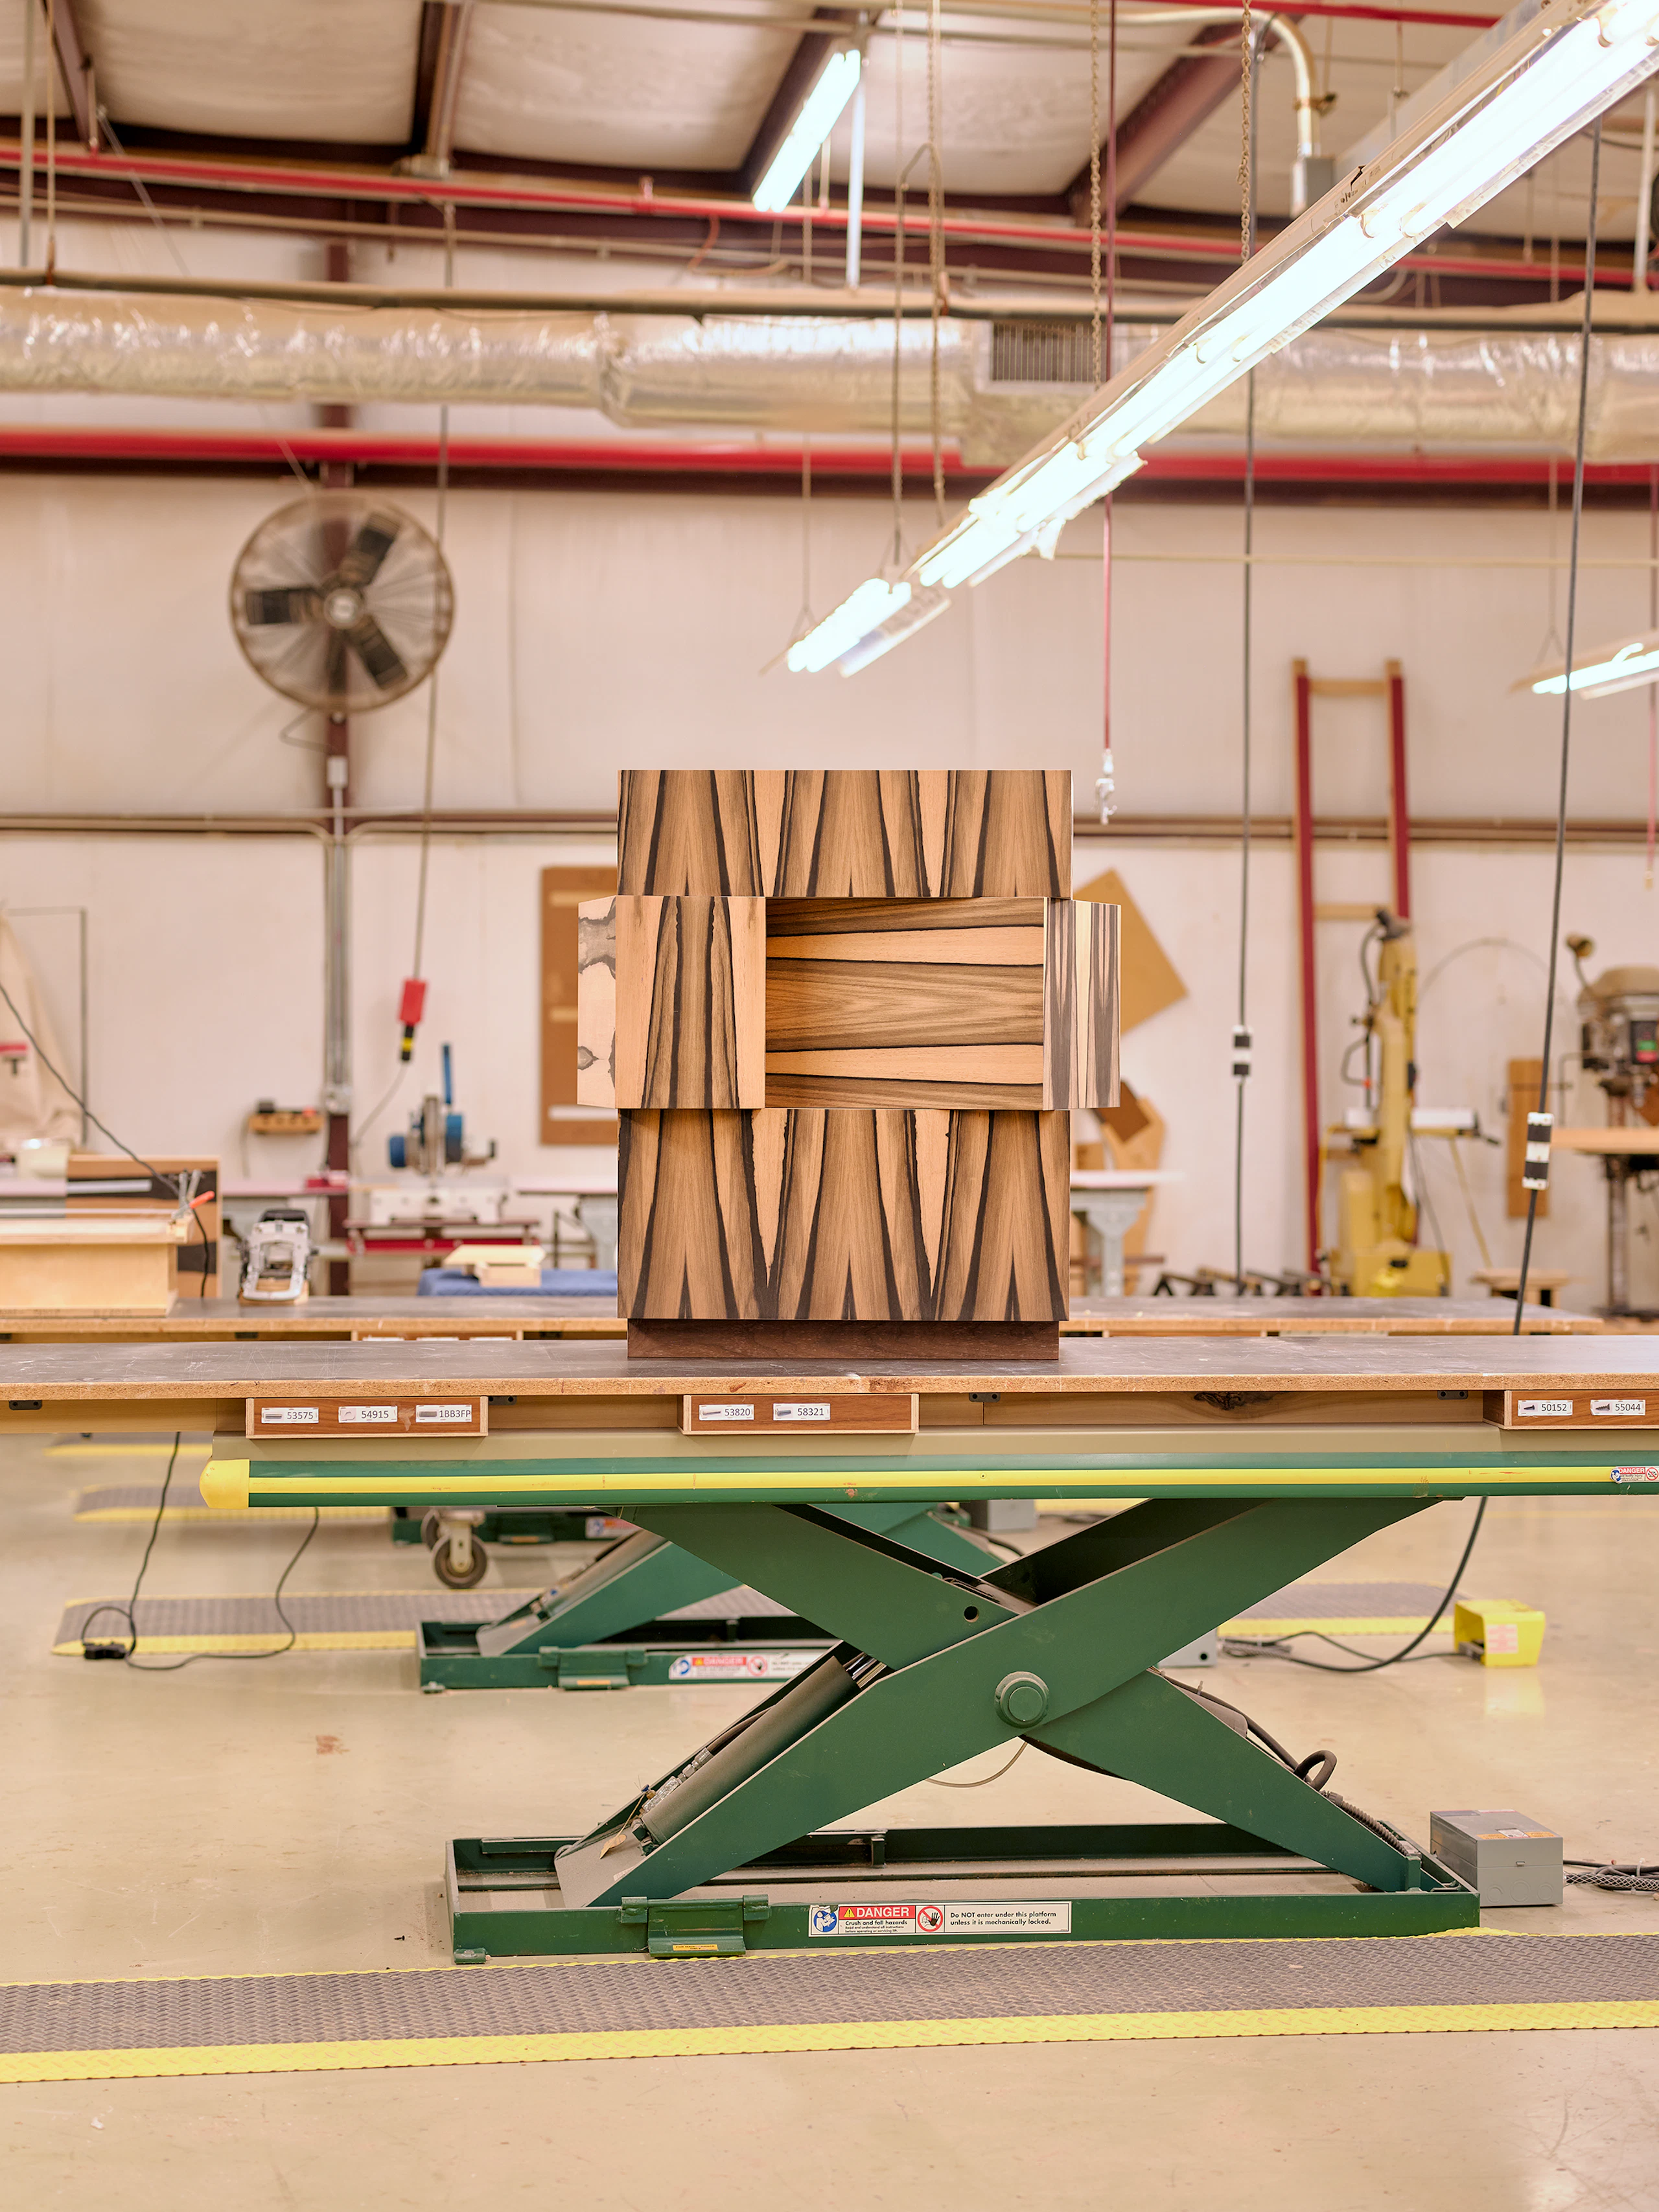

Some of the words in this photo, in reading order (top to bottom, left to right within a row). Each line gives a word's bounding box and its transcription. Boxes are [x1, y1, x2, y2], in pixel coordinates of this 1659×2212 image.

[797, 1408, 824, 1416] 58321
[1541, 1403, 1567, 1412] 50152
[361, 1410, 389, 1419] 54915
[857, 1907, 909, 1918] DANGER
